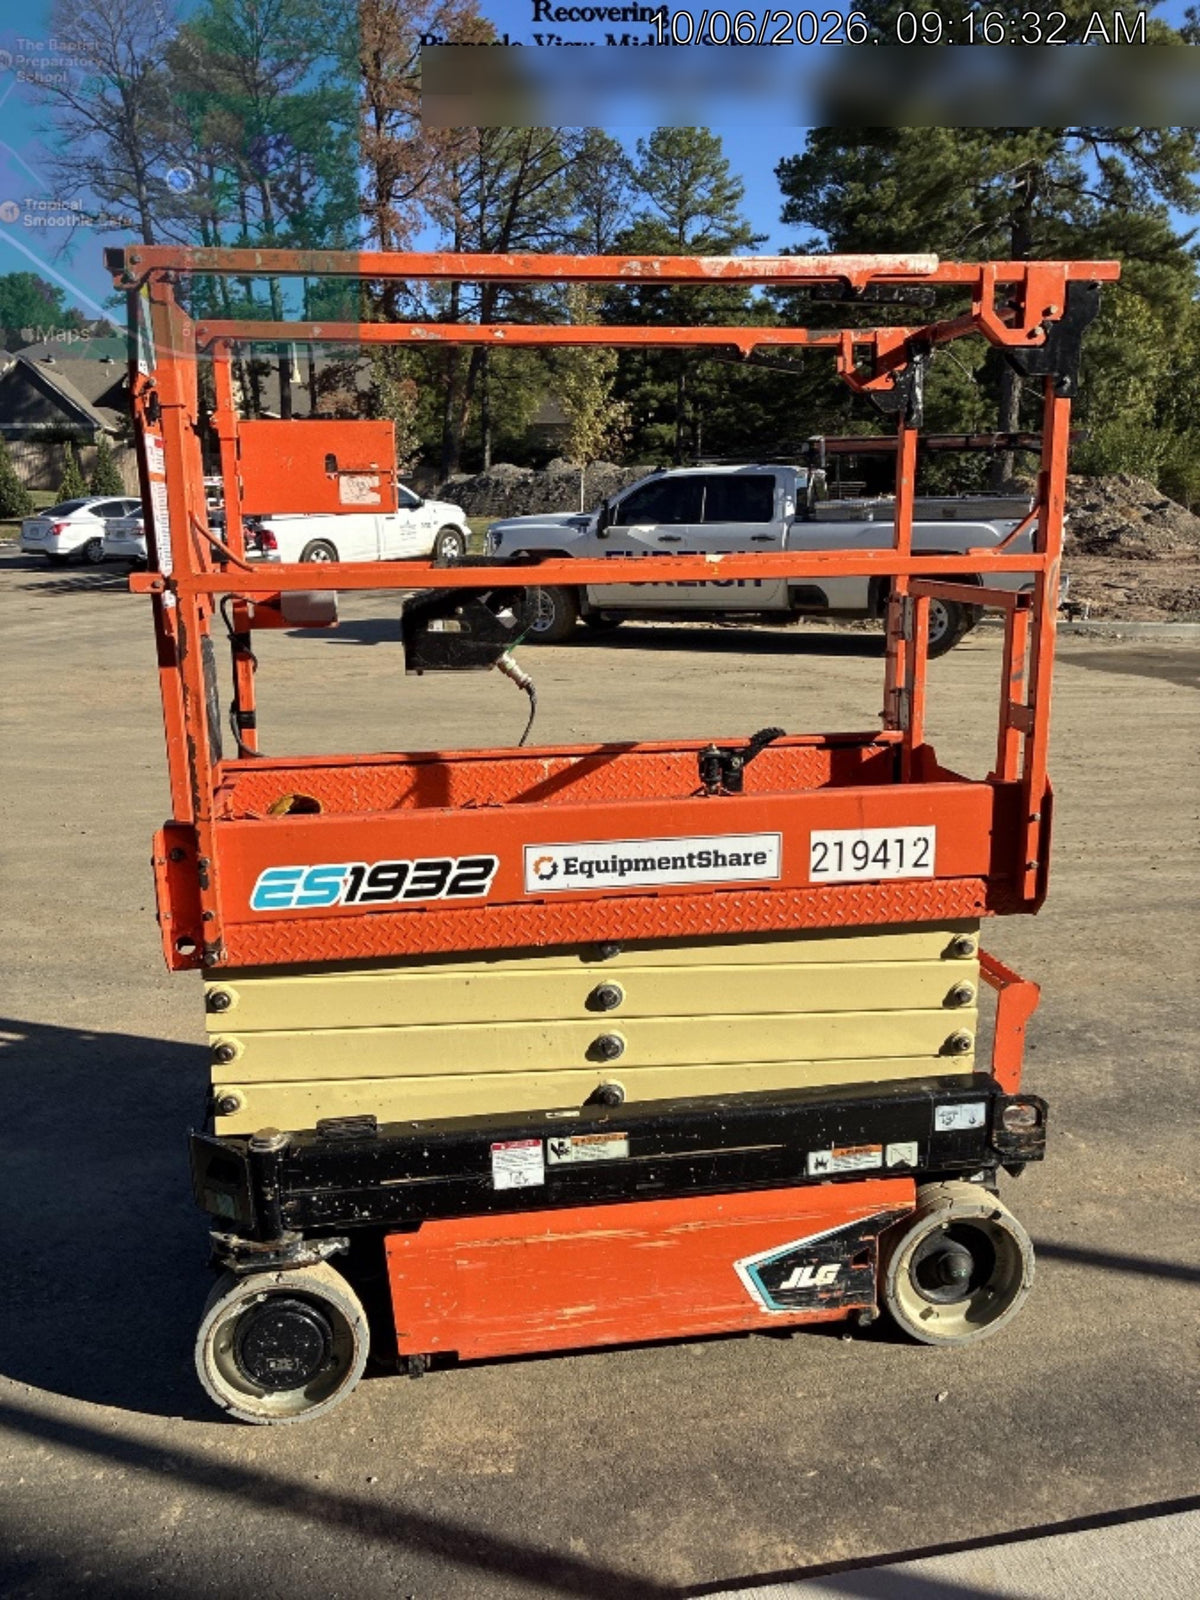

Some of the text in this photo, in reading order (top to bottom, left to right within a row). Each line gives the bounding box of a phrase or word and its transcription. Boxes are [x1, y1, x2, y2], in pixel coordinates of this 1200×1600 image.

[563, 850, 768, 879] EquipmentShare
[811, 836, 931, 874] 219412
[252, 857, 497, 909] ES1932
[779, 1263, 842, 1290] JLG
